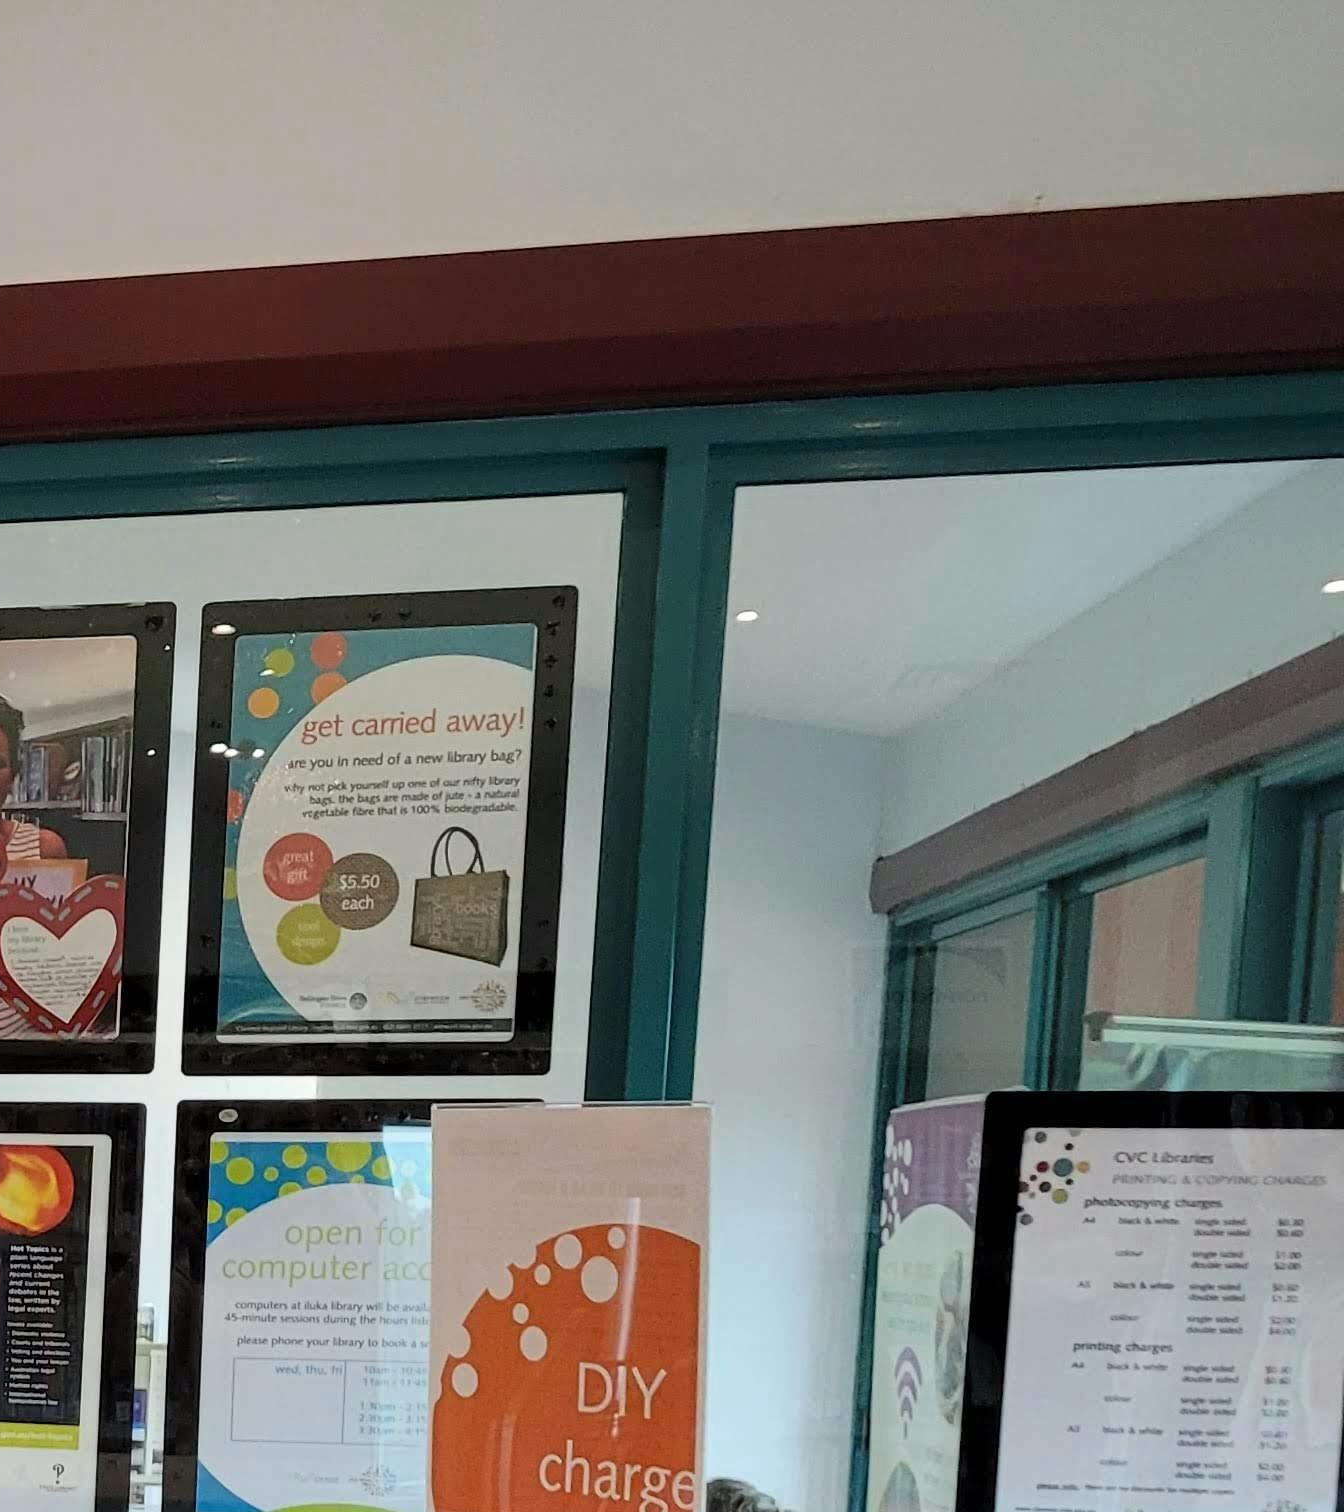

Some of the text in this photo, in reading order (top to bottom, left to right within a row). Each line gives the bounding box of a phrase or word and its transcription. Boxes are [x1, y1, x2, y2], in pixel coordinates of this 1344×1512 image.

[301, 706, 525, 745] get carried away!
[287, 749, 522, 772] are you in need of a new library bag?
[282, 850, 314, 866] great
[286, 868, 310, 885] gift
[339, 874, 380, 890] $5.50
[341, 896, 374, 911] each
[1114, 1151, 1214, 1164] CVC Libraries
[1174, 1198, 1223, 1210] charges
[285, 1218, 422, 1252] open for
[222, 1255, 372, 1287] computer
[235, 1301, 383, 1315] computers at library will
[224, 1312, 376, 1327] 45-minute sessions during the
[237, 1336, 379, 1350] please phone your library to
[577, 1361, 666, 1420] DIY
